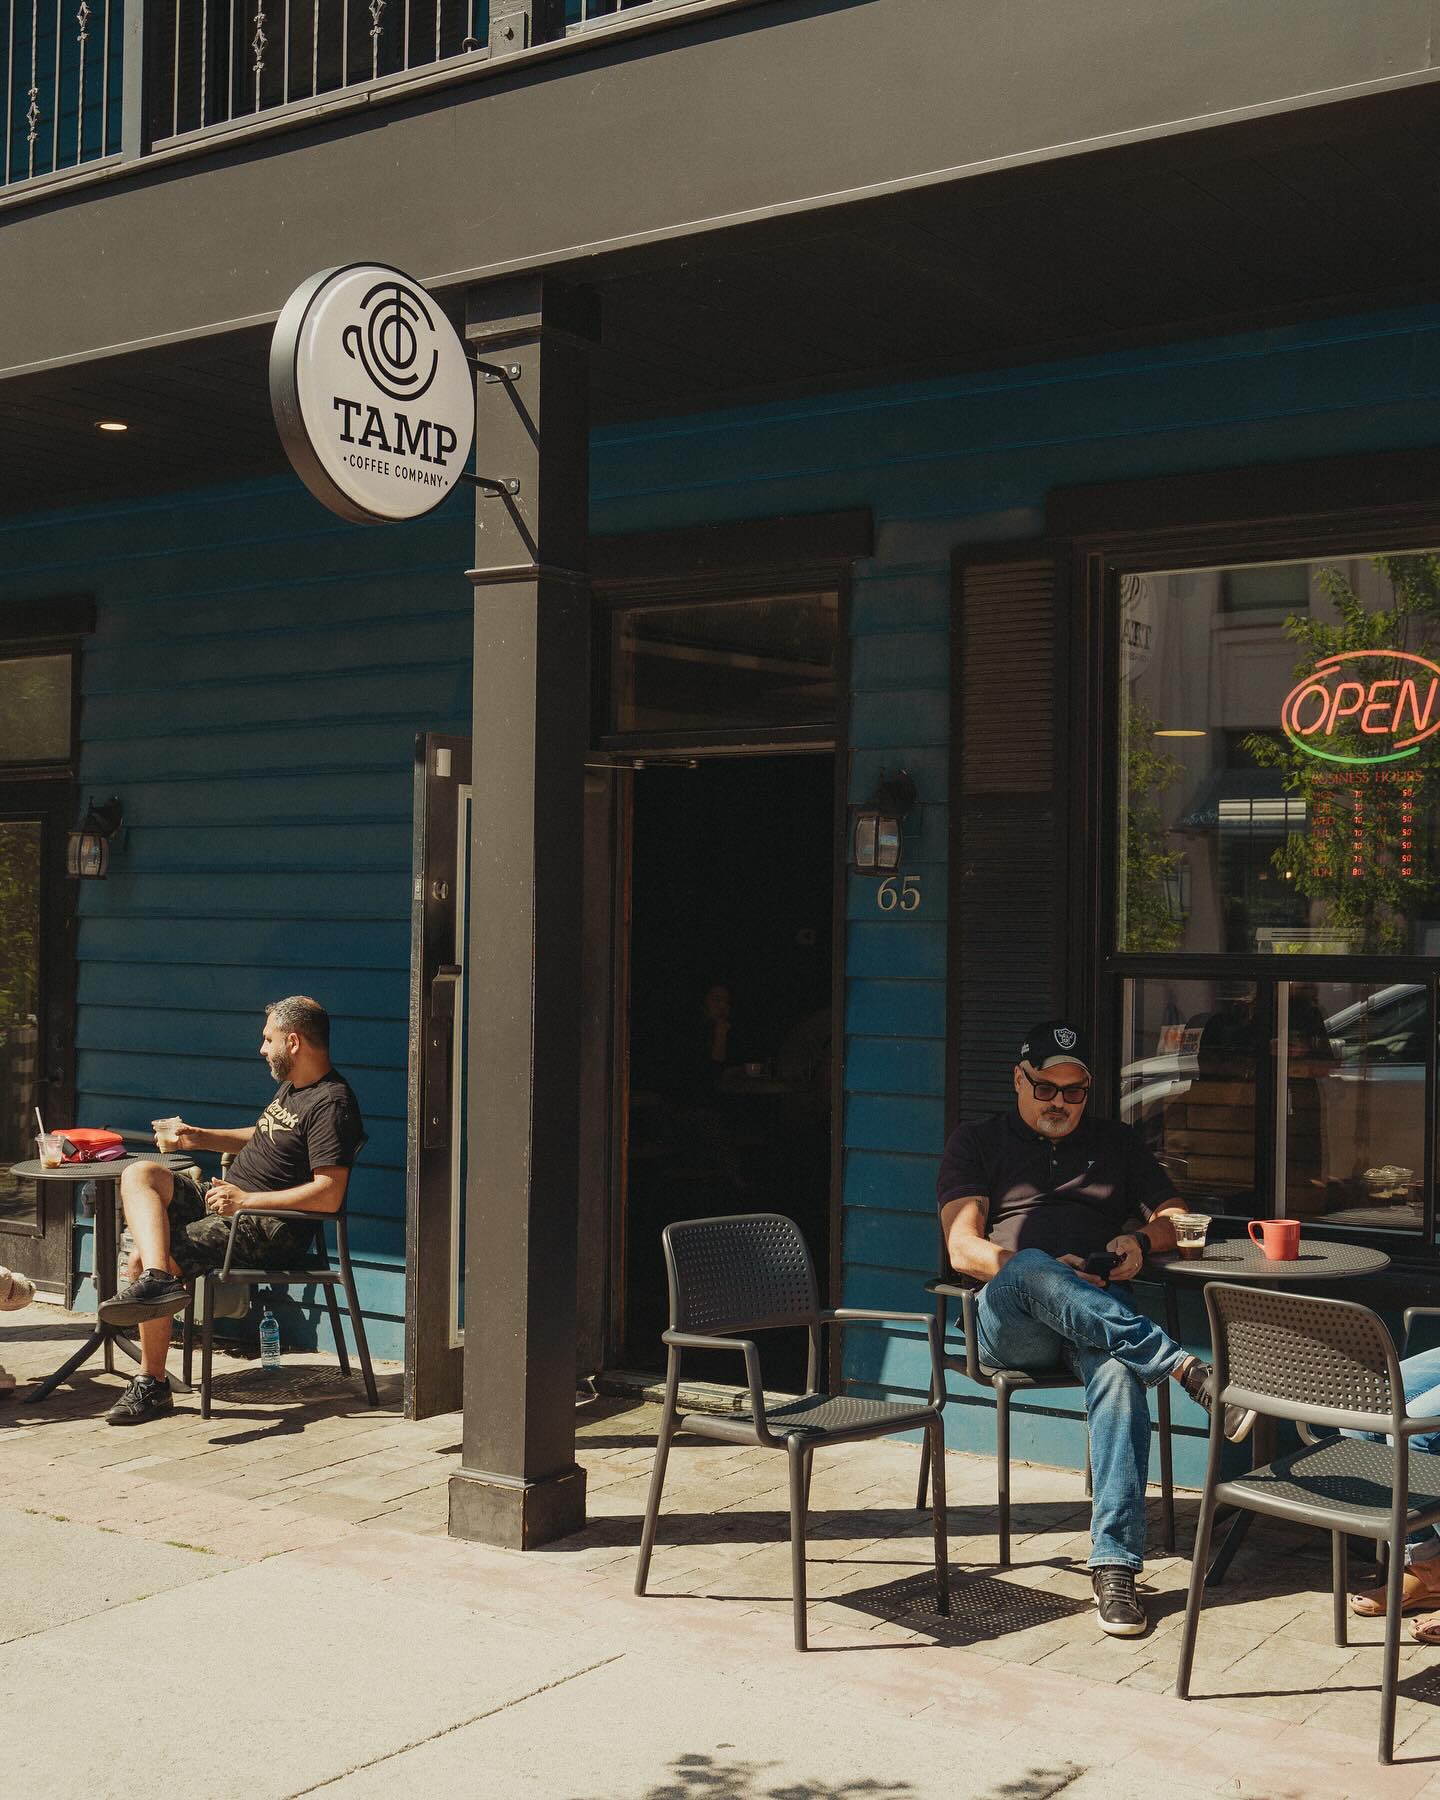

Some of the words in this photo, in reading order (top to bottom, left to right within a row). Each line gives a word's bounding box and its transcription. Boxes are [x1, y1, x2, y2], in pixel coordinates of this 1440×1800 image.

[333, 396, 457, 466] TAMP
[350, 454, 389, 475] COFFEE
[395, 465, 443, 487] COMPANY
[1291, 677, 1439, 736] OPEN
[1311, 771, 1369, 785] BUSINESS
[1375, 769, 1424, 784] HOURS
[877, 875, 922, 912] 65
